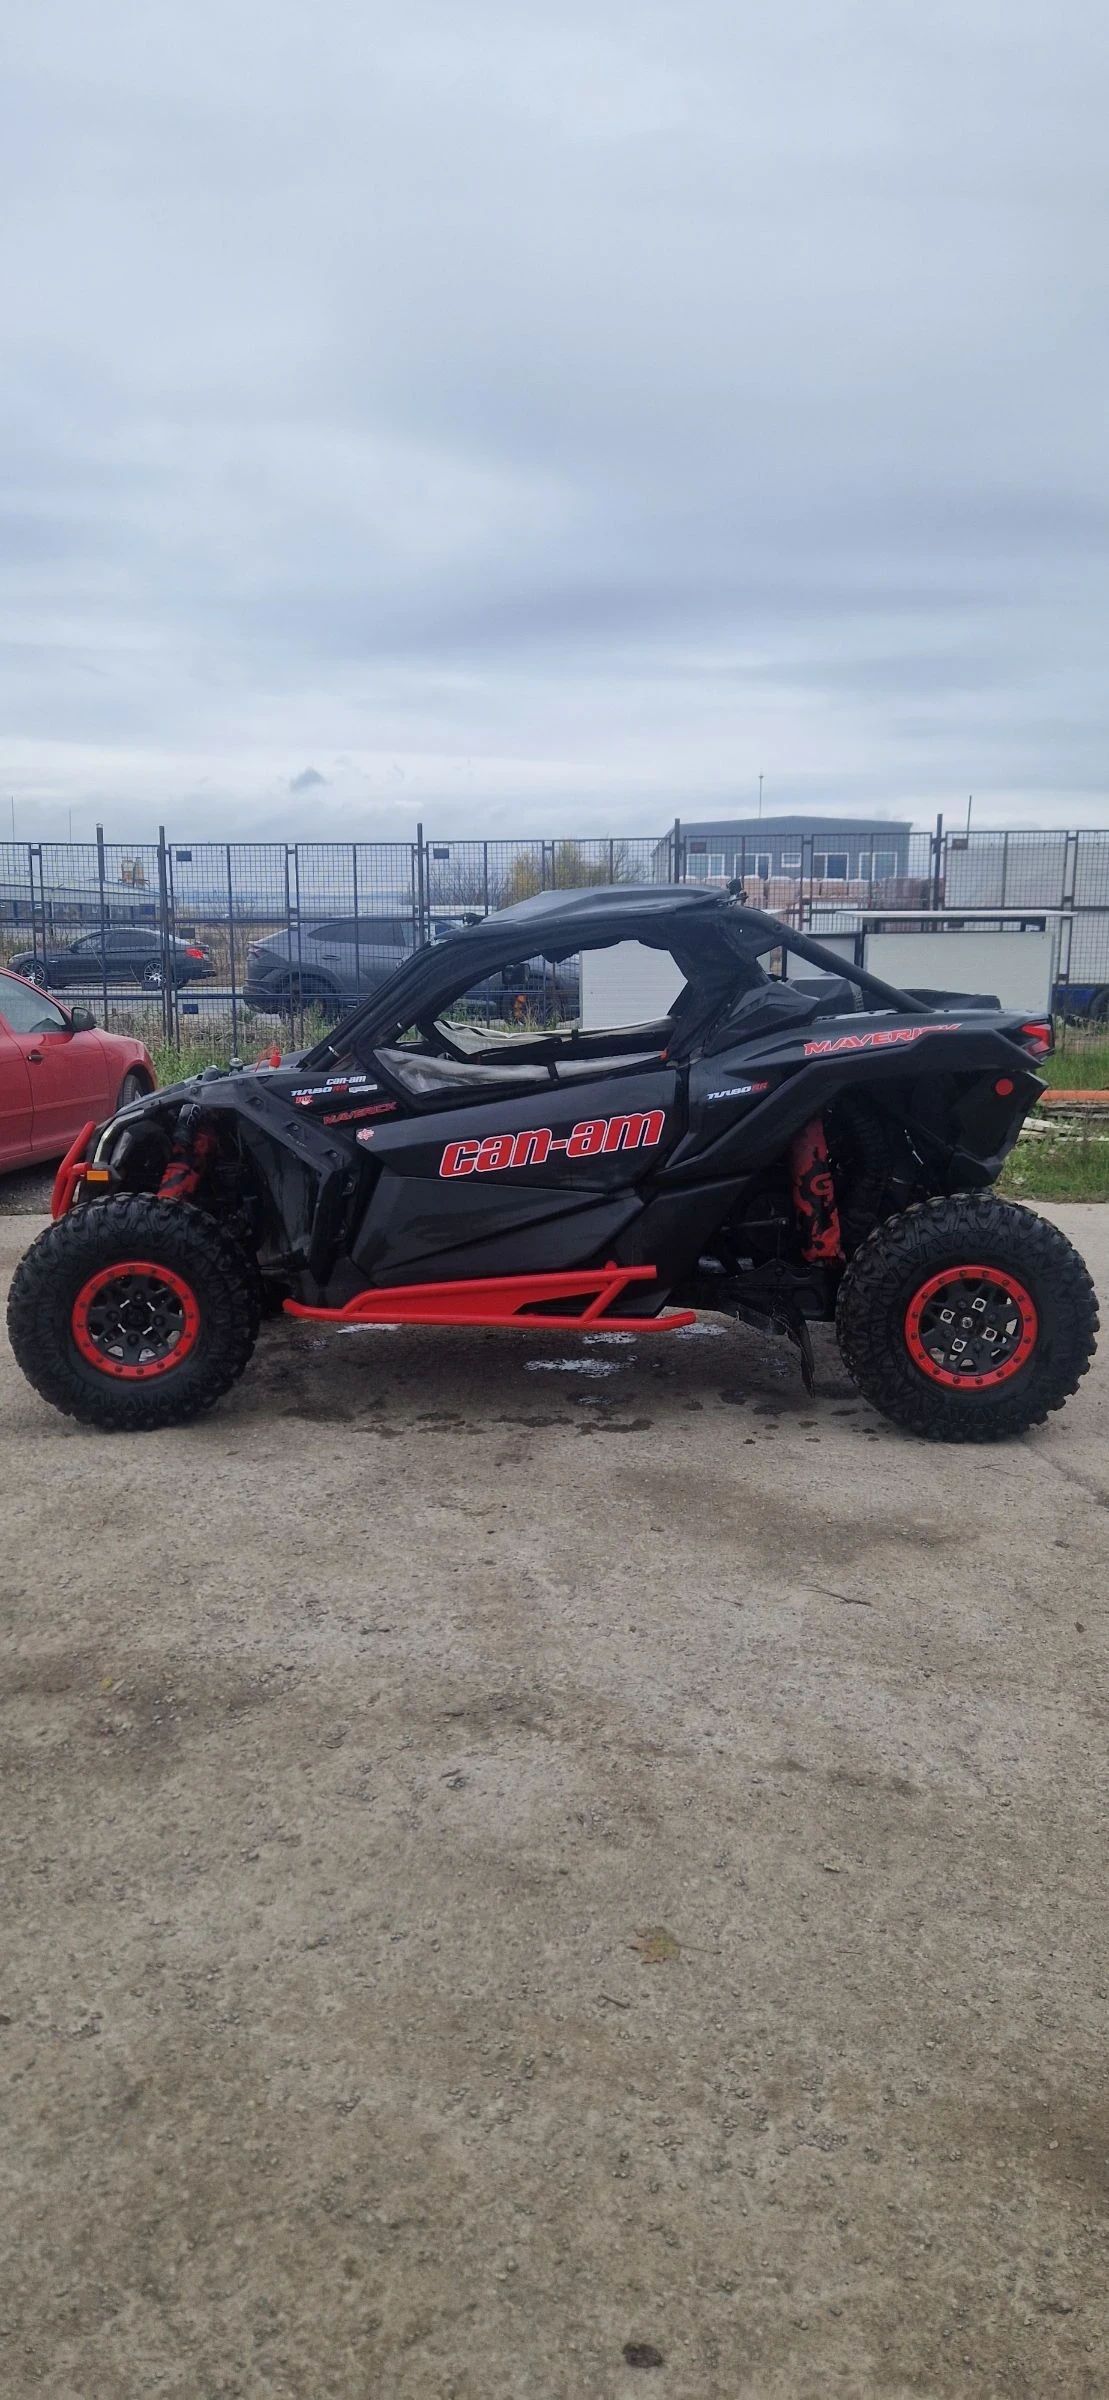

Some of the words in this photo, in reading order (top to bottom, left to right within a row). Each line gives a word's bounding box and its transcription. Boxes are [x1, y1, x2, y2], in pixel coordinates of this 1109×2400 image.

[804, 1023, 961, 1056] MAVERI
[327, 1076, 366, 1085] can-am
[323, 1101, 397, 1124] MAVERICK
[439, 1110, 665, 1177] can-am
